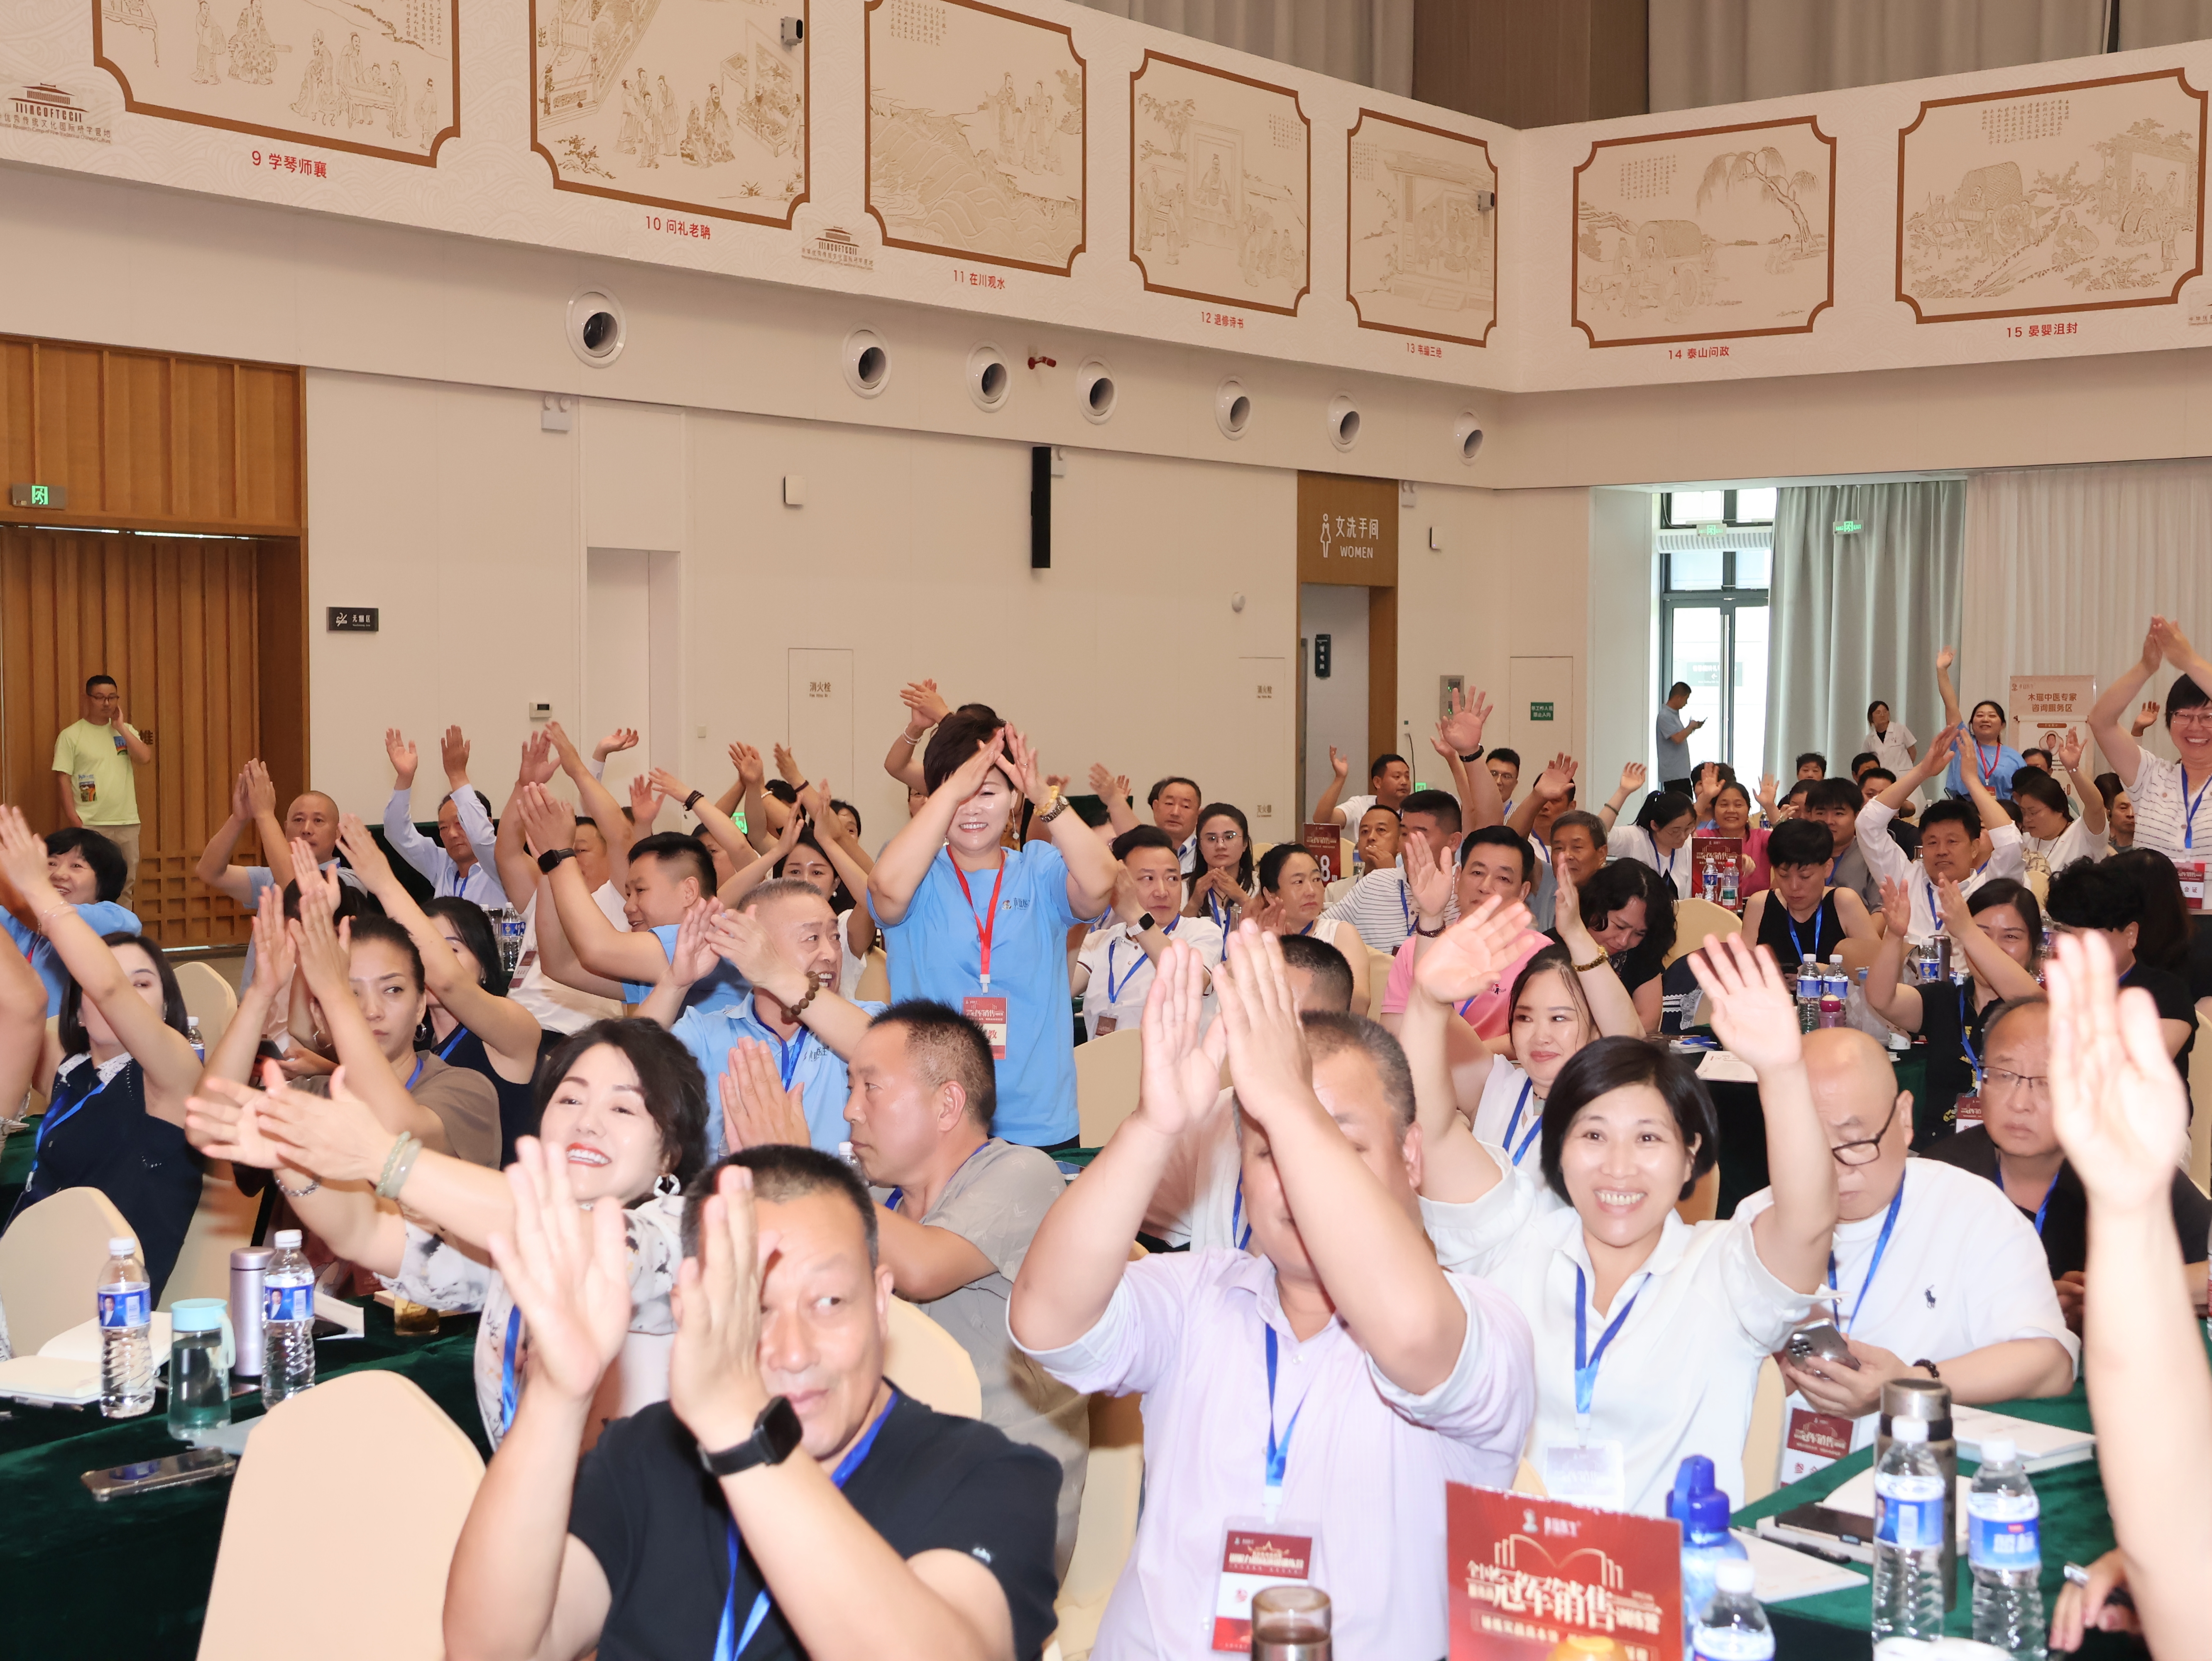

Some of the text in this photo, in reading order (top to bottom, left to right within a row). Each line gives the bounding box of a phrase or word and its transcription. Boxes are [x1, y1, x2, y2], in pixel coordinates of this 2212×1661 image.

[0, 113, 110, 138] 优秀传统文化国际研学营地
[252, 151, 327, 178] 9 学琴师襄
[646, 216, 710, 240] 10 问礼老聃
[954, 270, 1005, 289] 11 在川观水
[1201, 311, 1211, 323] 12
[2007, 322, 2077, 338] 15 晏婴沮封
[1407, 343, 1414, 353] 13
[1669, 346, 1730, 360] 14 泰山问政
[1336, 515, 1378, 540] 女洗手间
[1340, 546, 1373, 559] WOMEN
[810, 681, 831, 692] 消火栓
[2032, 704, 2073, 712] 咨询服务区
[989, 1030, 997, 1039] 教
